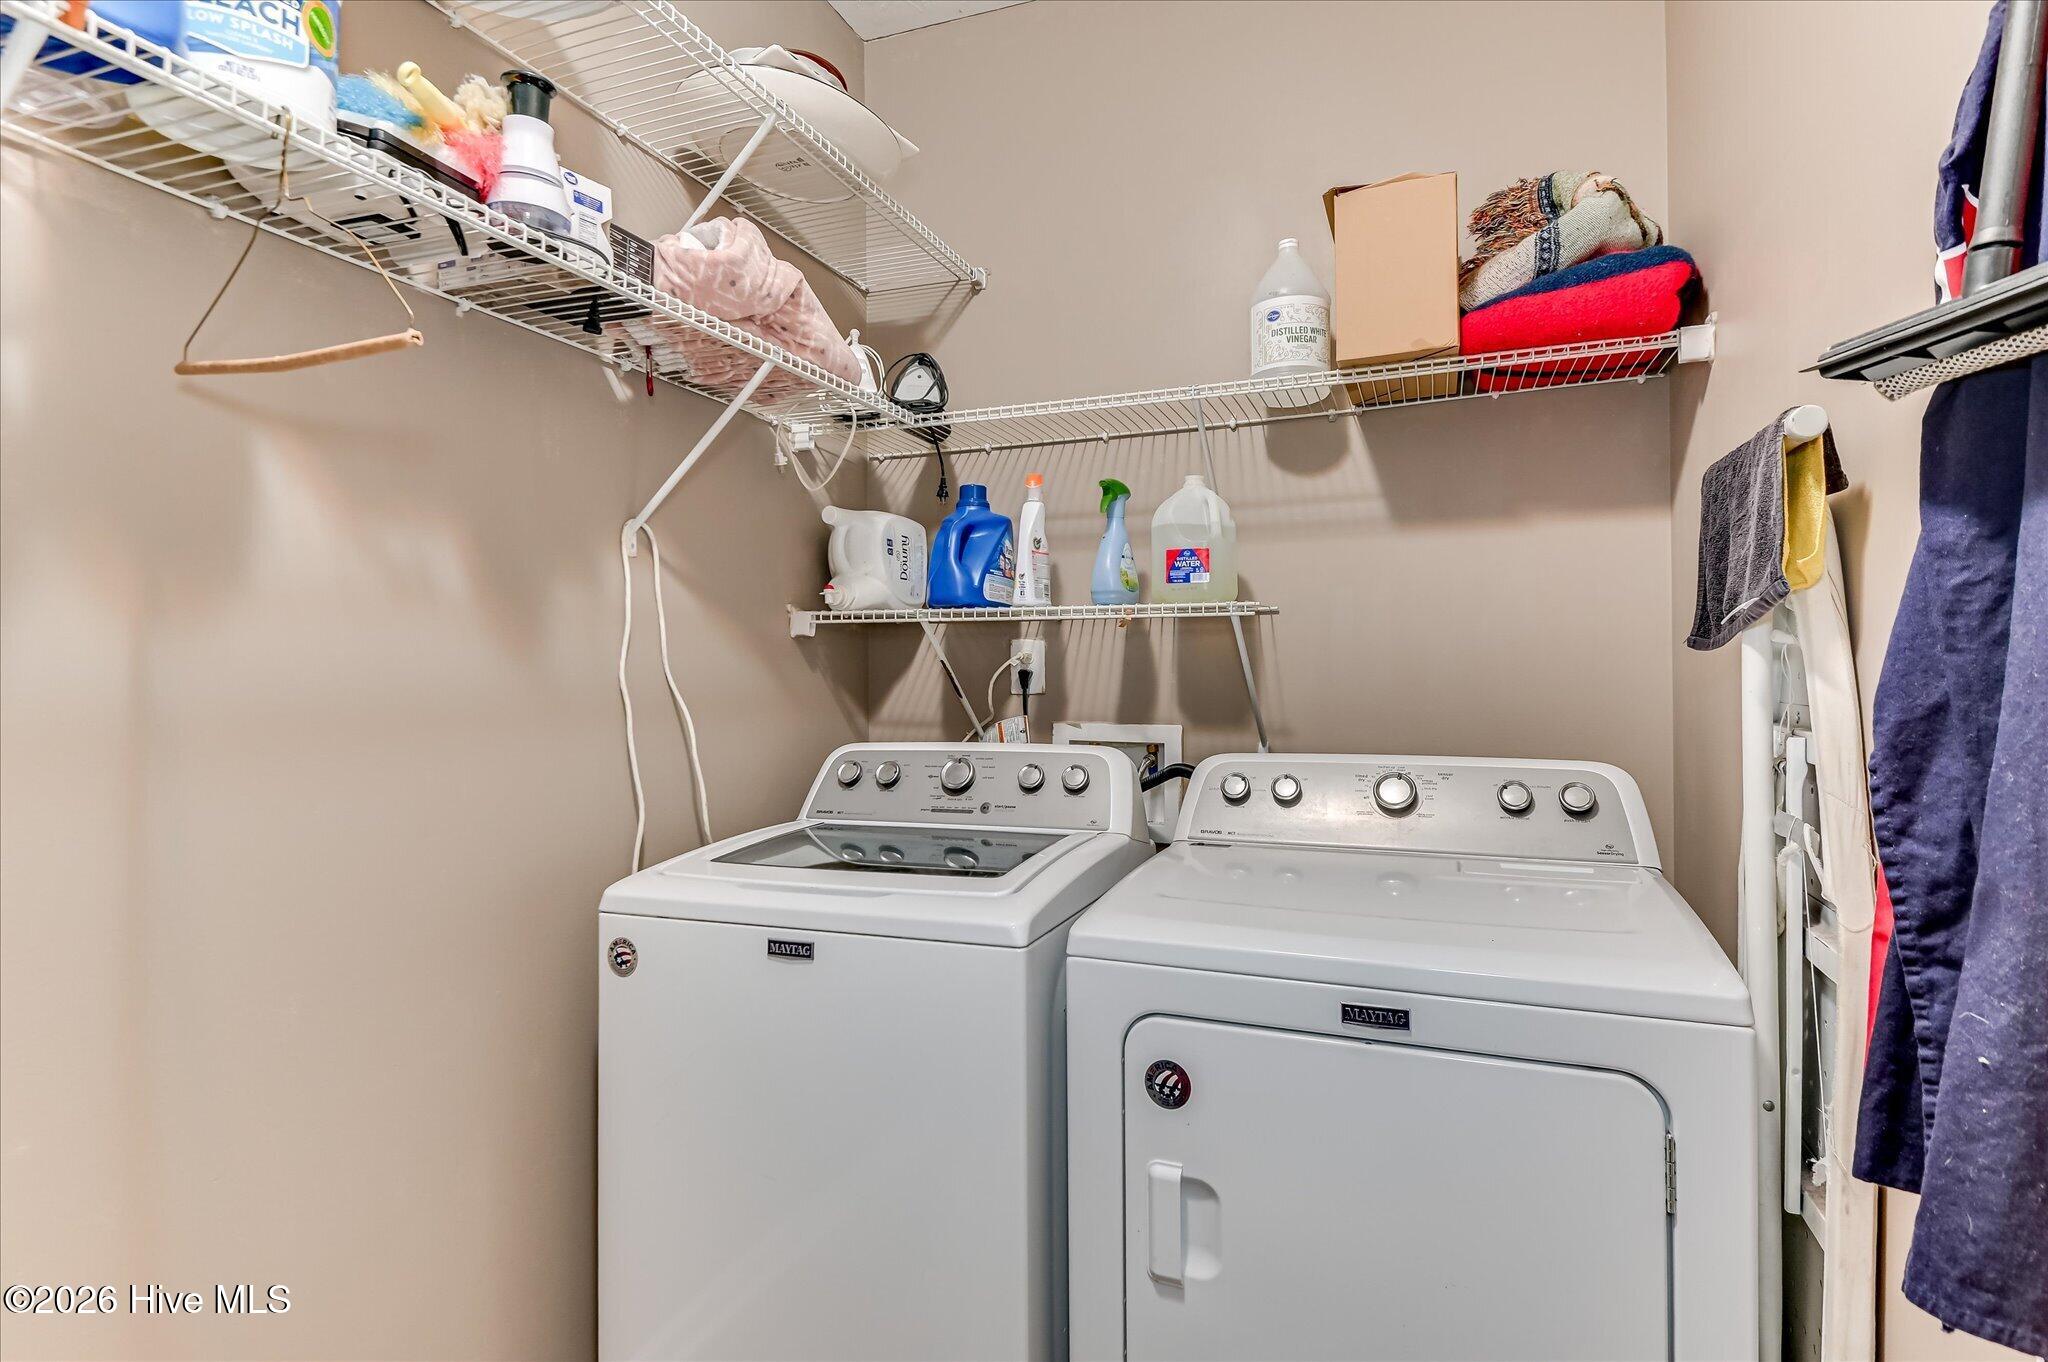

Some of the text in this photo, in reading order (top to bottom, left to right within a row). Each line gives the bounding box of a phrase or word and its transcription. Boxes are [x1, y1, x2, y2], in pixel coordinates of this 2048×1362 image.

[186, 9, 224, 24] LOW
[230, 18, 294, 50] SPLASH
[1271, 326, 1327, 338] DISTILLED WHITE
[1286, 335, 1317, 344] VINEGAR
[900, 535, 910, 581] Downy
[609, 938, 636, 955] AMERICA
[769, 942, 811, 956] MAYTAG
[1344, 1007, 1406, 1025] MAYTAG
